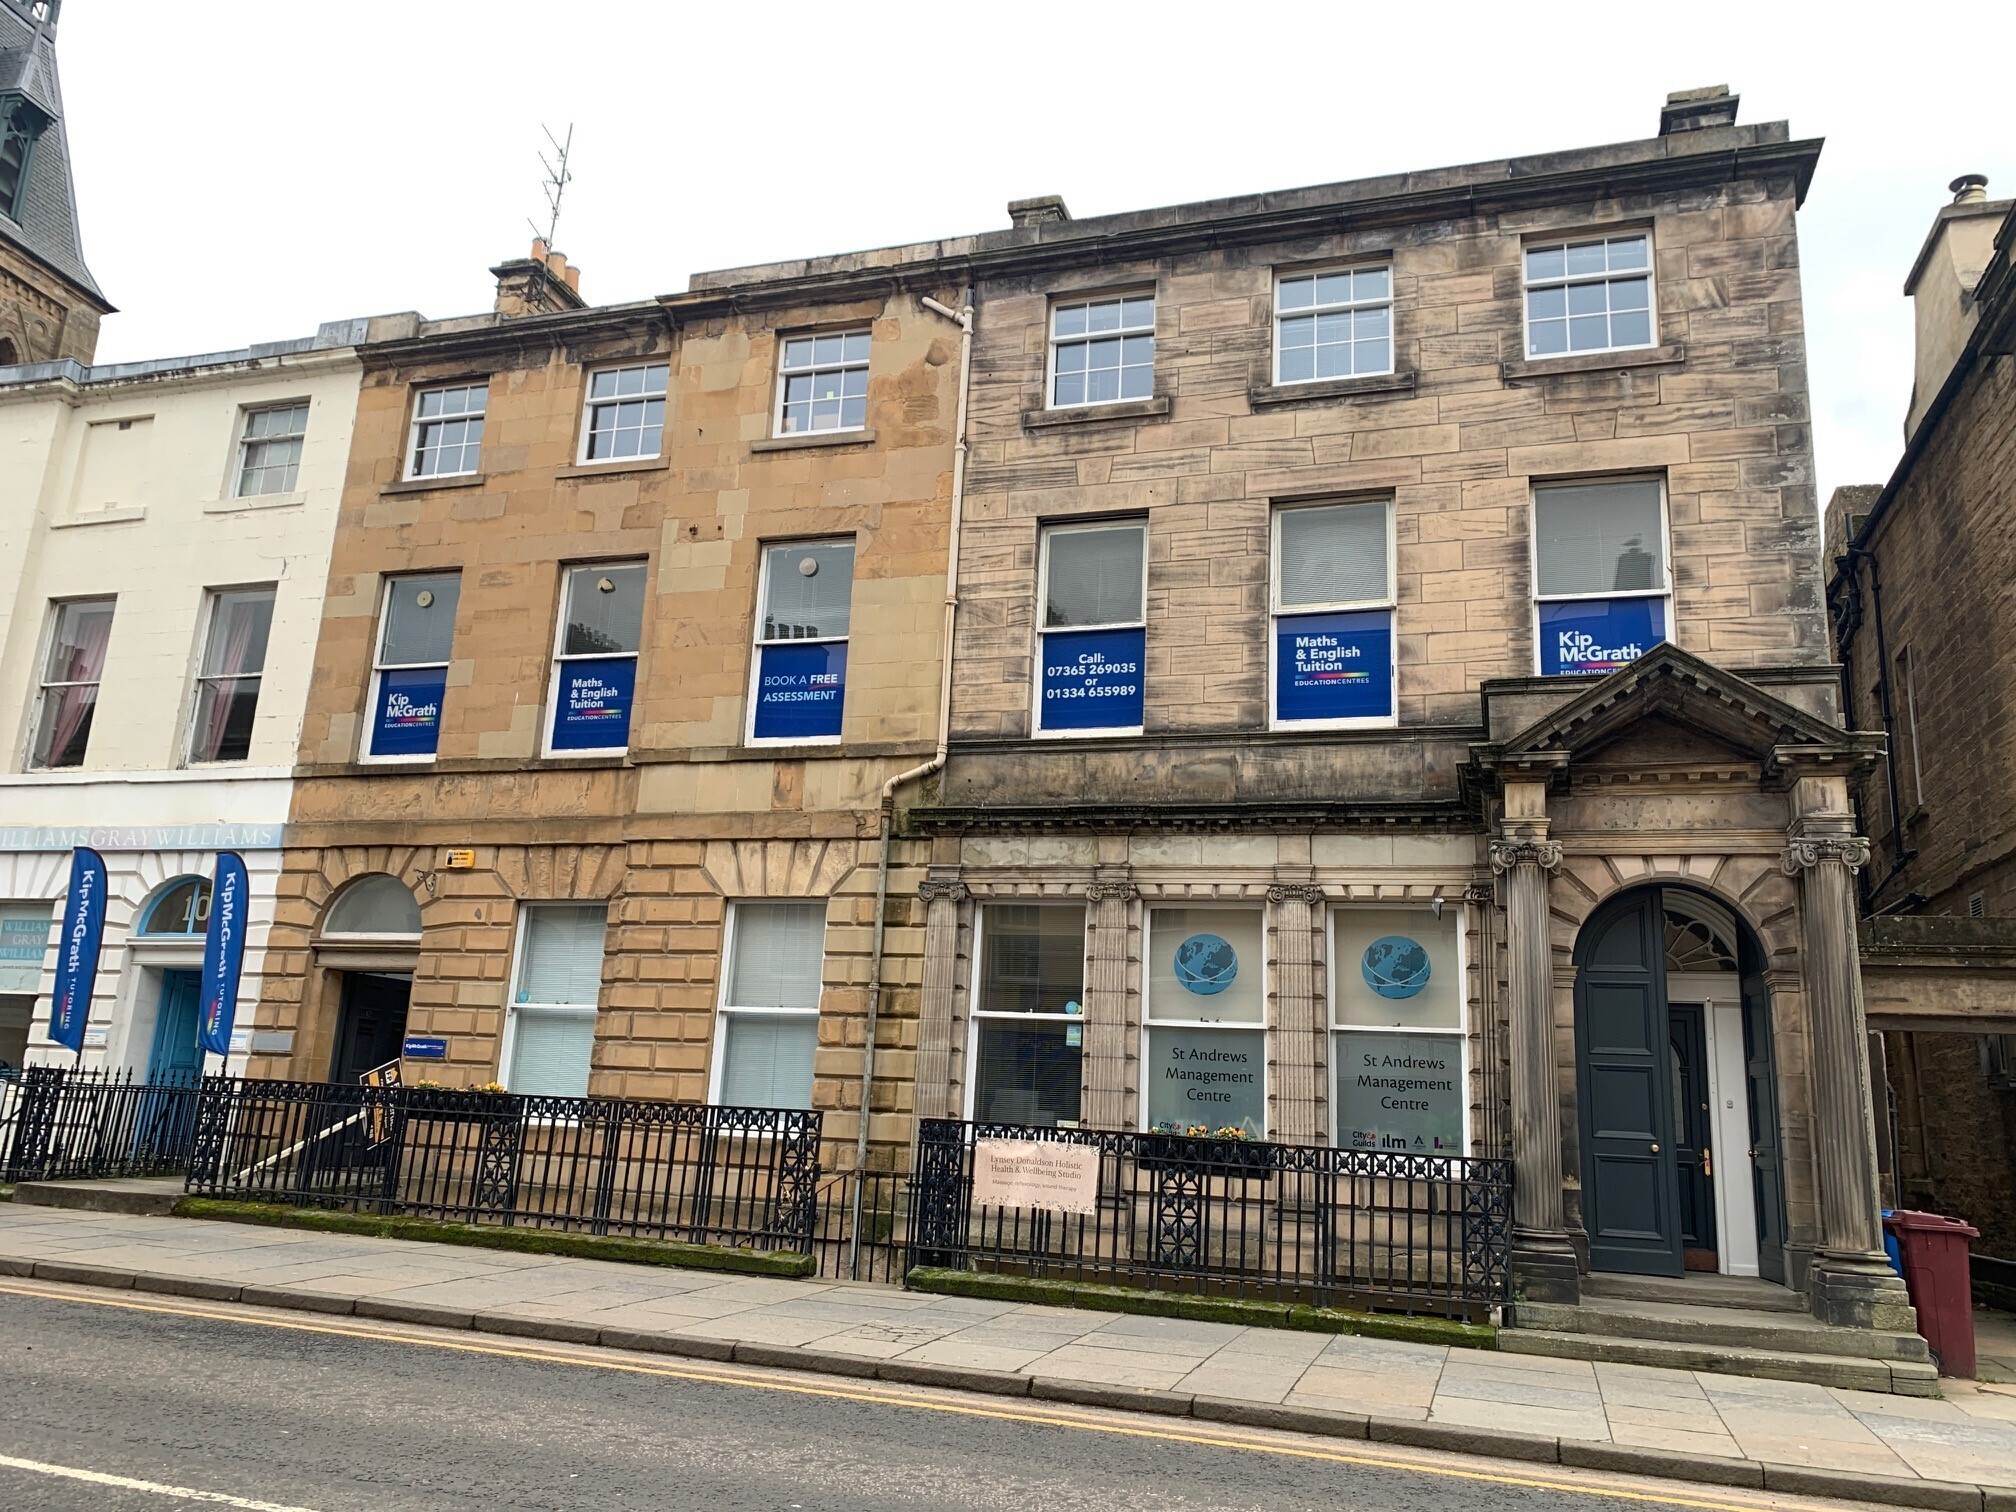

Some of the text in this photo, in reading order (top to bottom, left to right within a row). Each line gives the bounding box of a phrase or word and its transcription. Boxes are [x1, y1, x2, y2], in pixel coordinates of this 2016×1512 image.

[1296, 635, 1338, 648] Maths
[1559, 631, 1592, 651] Kip
[1078, 653, 1105, 664] Call:
[1295, 646, 1360, 661] & English
[1560, 643, 1642, 662] McGrath
[1047, 663, 1136, 677] 07365 269035
[1295, 660, 1342, 672] Tuition
[572, 677, 603, 688] Maths
[764, 674, 838, 686] BOOK A FREE
[1084, 677, 1098, 686] or
[570, 687, 618, 700] & English
[763, 690, 837, 702] ASSESSMENT
[1046, 686, 1136, 699] 01334 655989
[388, 693, 410, 709] Kip
[570, 699, 604, 709] Tuition
[386, 703, 437, 718] McGrath
[0, 827, 272, 847] ILLIAMS GRAY WILLIAMS
[12, 934, 44, 945] GRAY
[64, 977, 76, 1030] TUTORING
[212, 982, 225, 1036] TUTORING
[1172, 1047, 1248, 1062] St Andrews
[1364, 1054, 1445, 1070] St Andrews
[1166, 1067, 1254, 1084] Management
[1357, 1074, 1452, 1092] Management
[1186, 1088, 1232, 1102] Centre
[1381, 1096, 1429, 1110] Centre
[1352, 1139, 1376, 1148] Guilds
[1382, 1134, 1406, 1149] ilm
[990, 1155, 1082, 1170] Lynsey Donaldson Holistic
[991, 1164, 1082, 1180] Health & Wellbeing Studio
